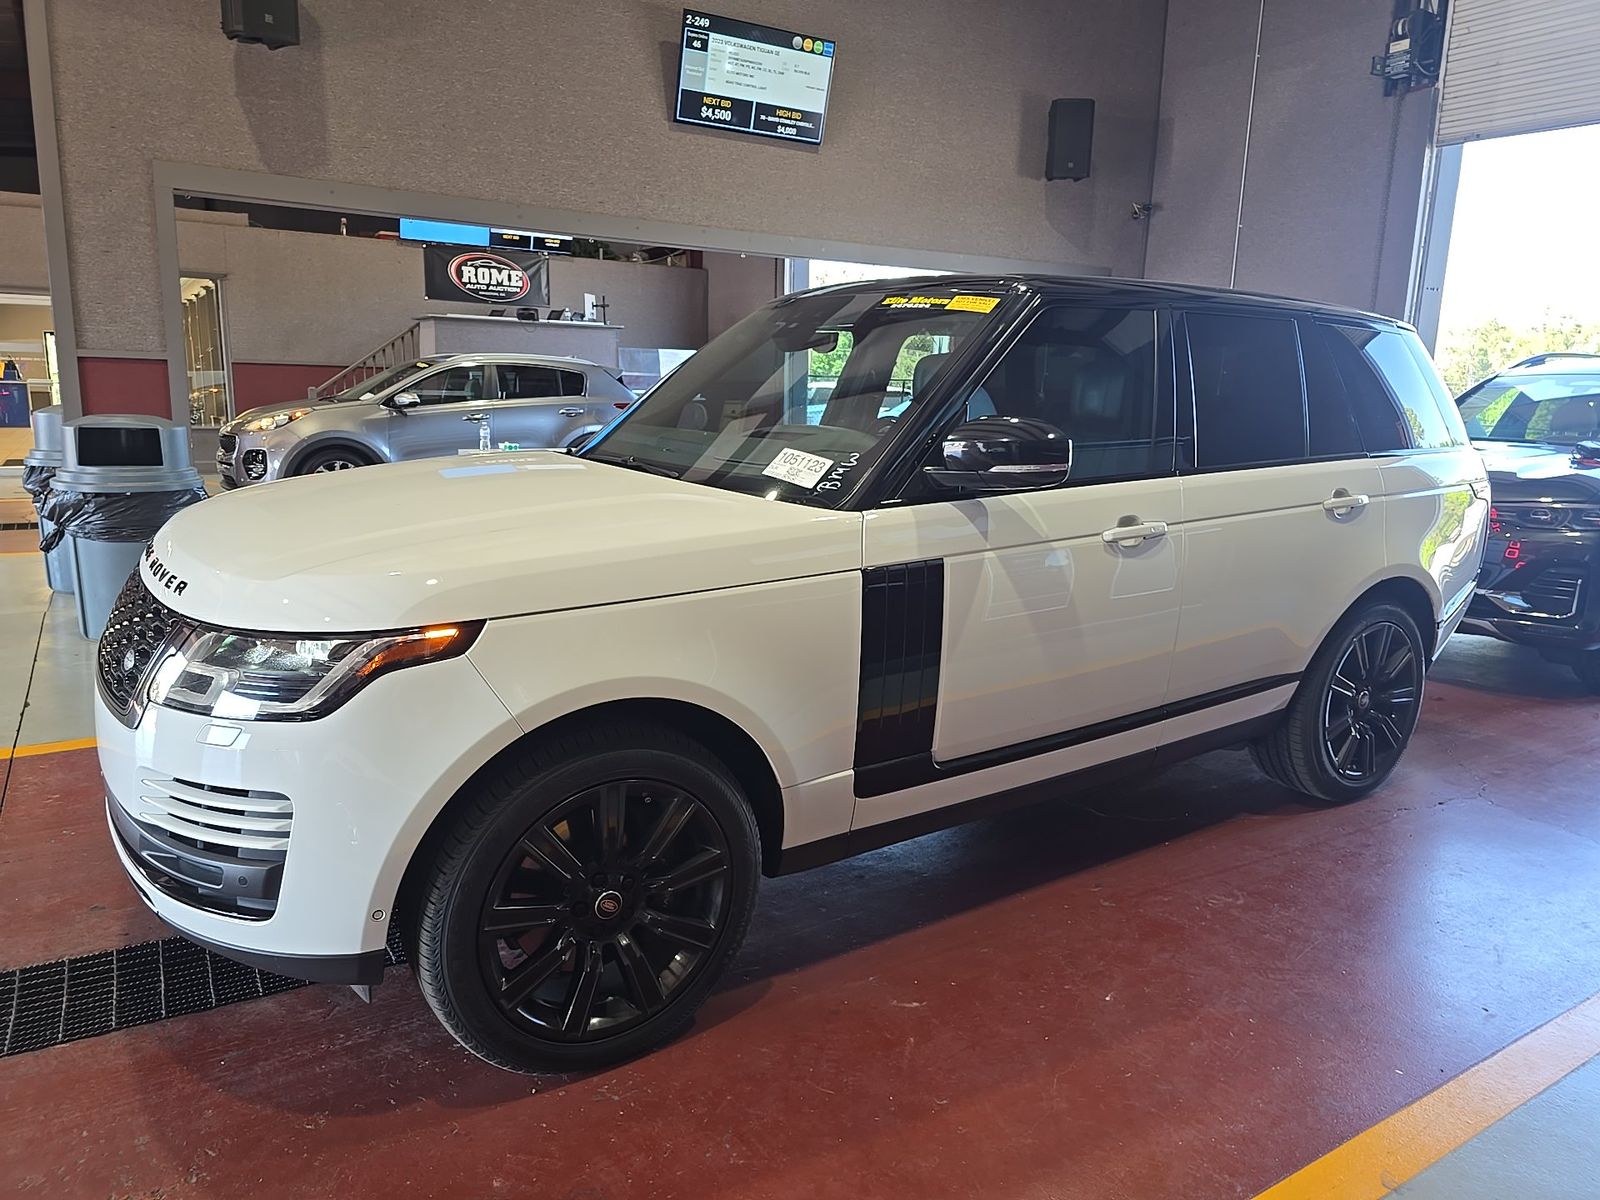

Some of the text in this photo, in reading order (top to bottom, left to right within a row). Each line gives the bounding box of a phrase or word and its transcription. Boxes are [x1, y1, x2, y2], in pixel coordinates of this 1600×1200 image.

[686, 14, 710, 28] 2-249
[692, 40, 702, 48] 46
[724, 40, 756, 52] VOLKSWAGEN
[756, 47, 774, 55] TIGUAN
[703, 96, 732, 108] NEXT BID
[700, 106, 731, 121] $4,500
[776, 108, 791, 118] HIGH
[792, 111, 802, 120] BID
[461, 266, 523, 287] ROME
[908, 296, 951, 305] Motors
[779, 452, 826, 473] 1051123
[149, 557, 188, 596] ROVER
